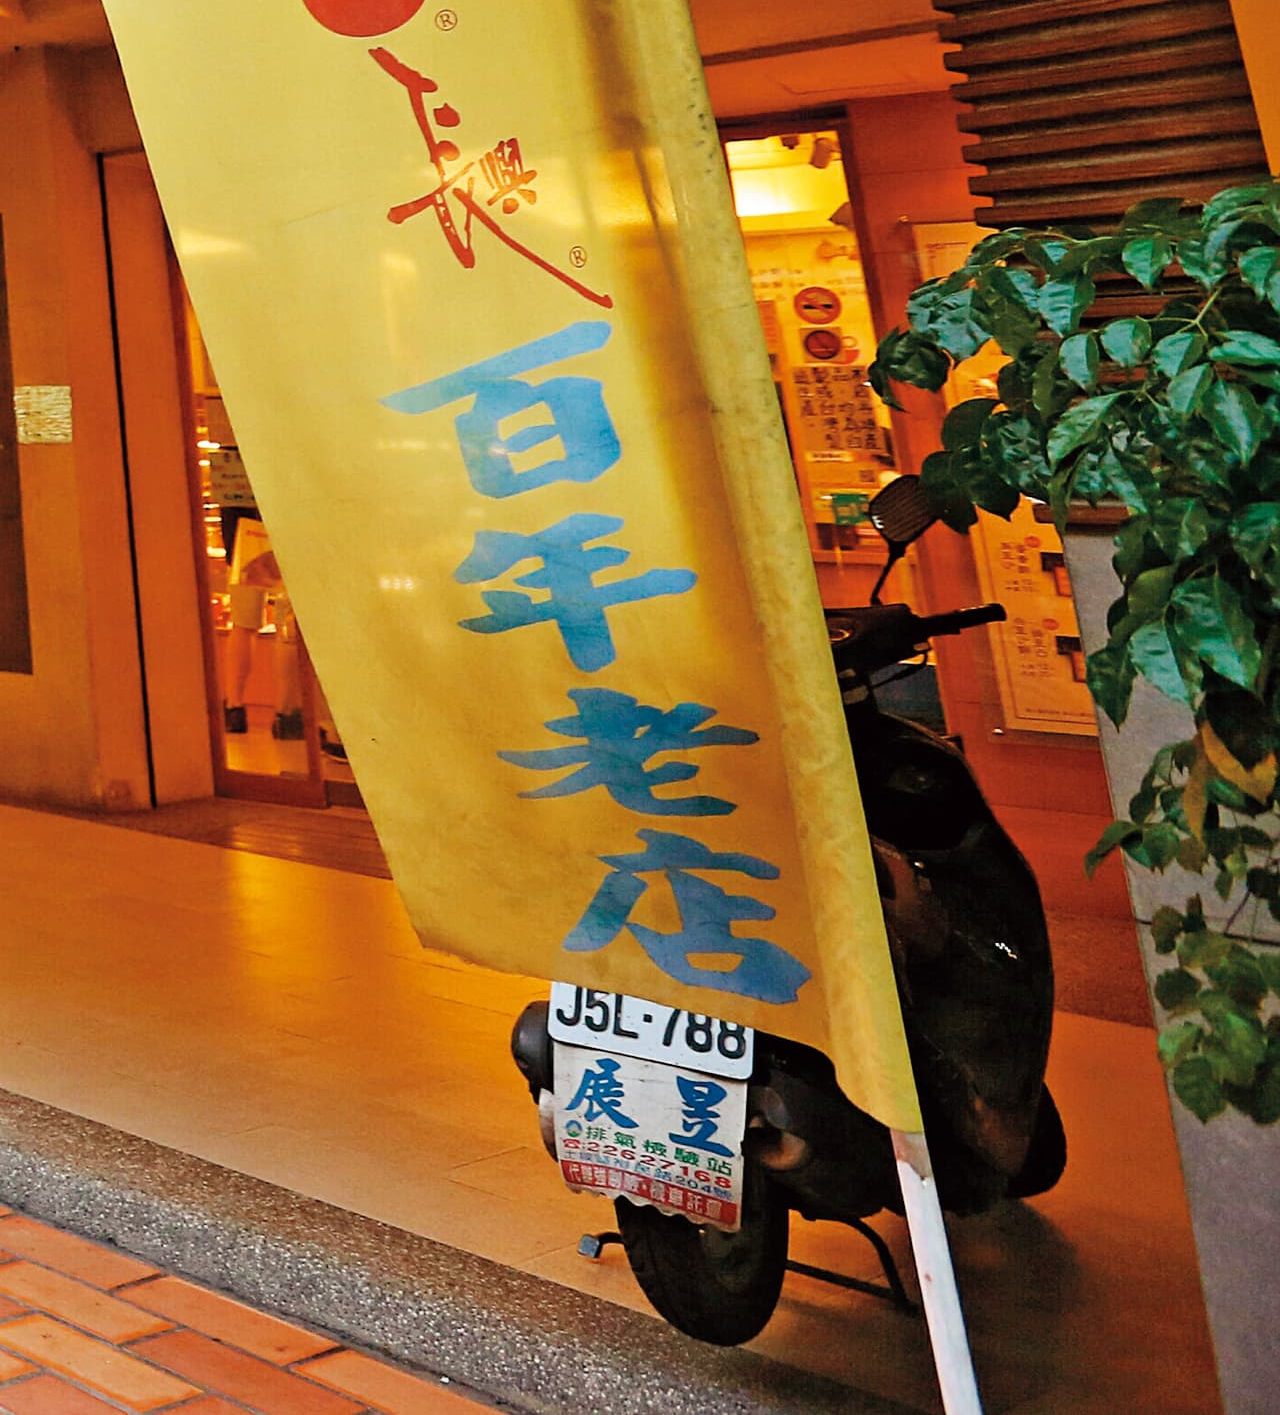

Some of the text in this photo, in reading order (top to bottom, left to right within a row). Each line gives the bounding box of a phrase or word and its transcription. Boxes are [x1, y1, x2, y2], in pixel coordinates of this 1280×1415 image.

[379, 319, 812, 1005] 百年老店
[585, 1126, 733, 1177] 排氣檢驗站
